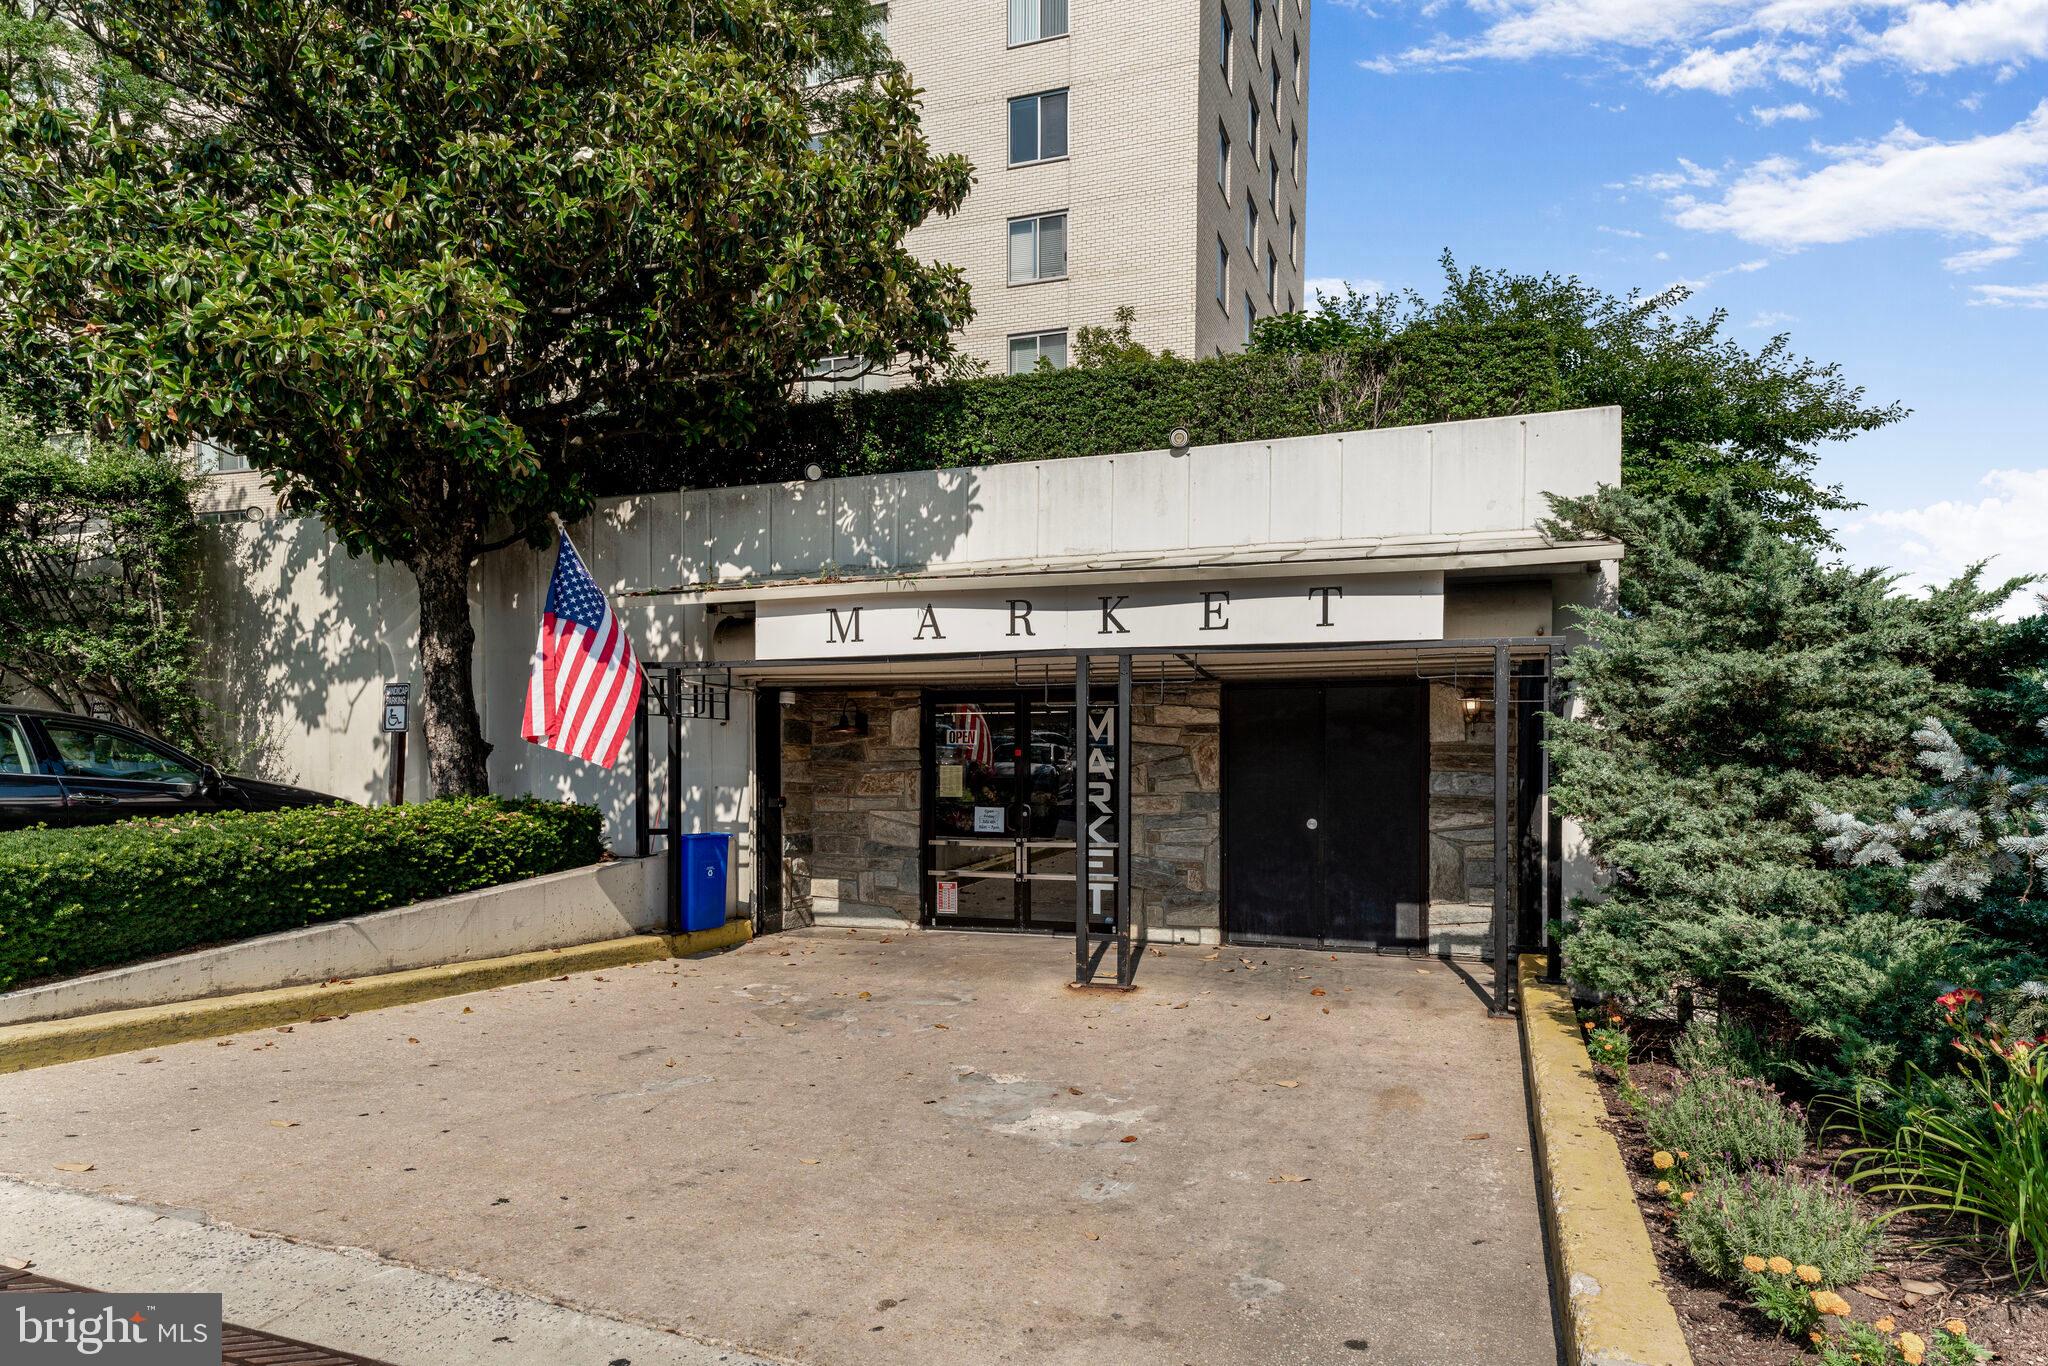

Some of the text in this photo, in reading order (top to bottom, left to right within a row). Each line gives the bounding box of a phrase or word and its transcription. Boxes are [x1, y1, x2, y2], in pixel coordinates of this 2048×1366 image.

[826, 586, 1343, 644] MARKET
[385, 696, 407, 705] PARKING
[949, 731, 976, 744] OPEN
[1088, 708, 1115, 915] MARKET
